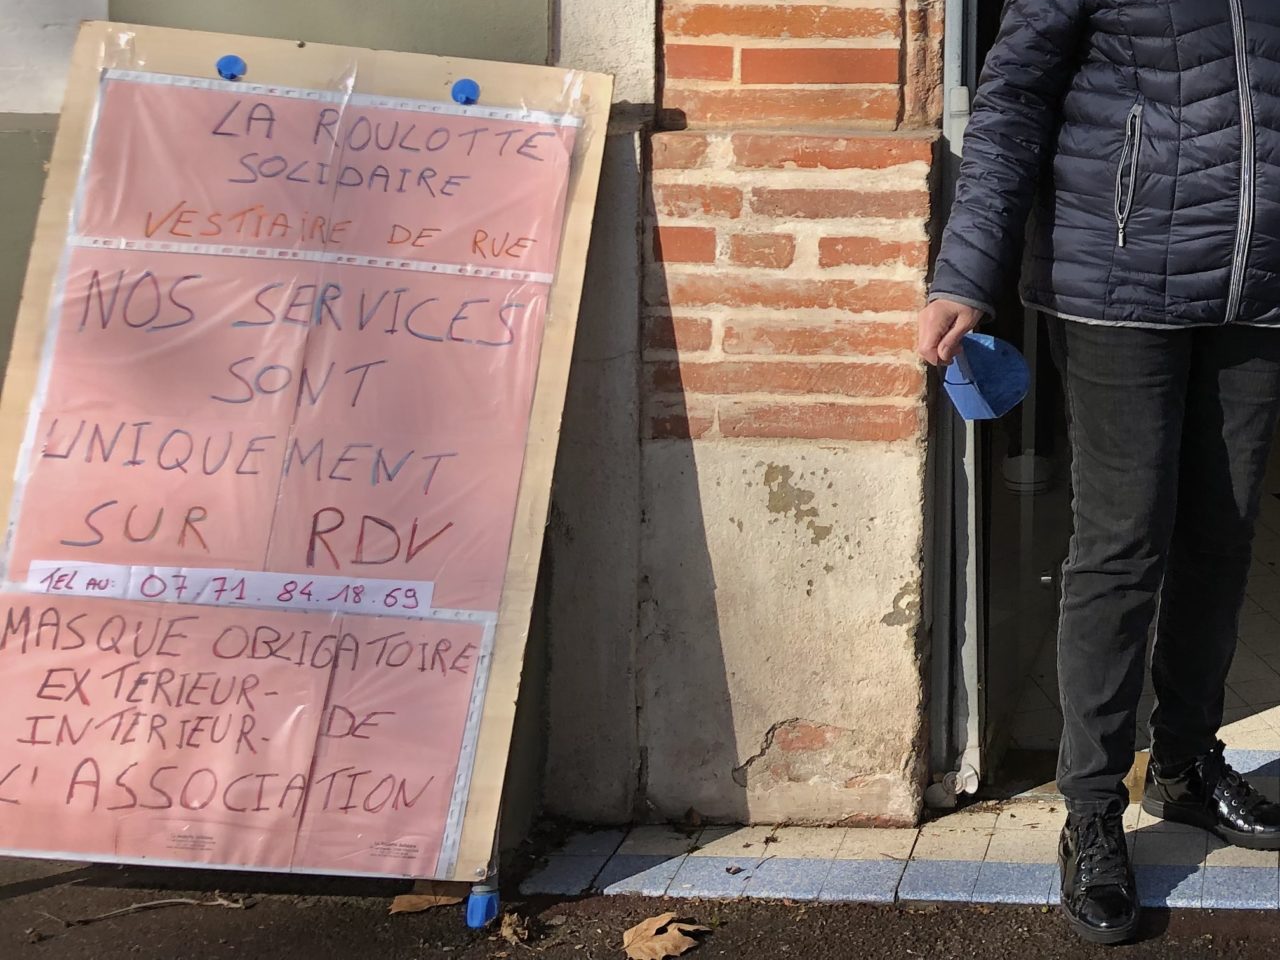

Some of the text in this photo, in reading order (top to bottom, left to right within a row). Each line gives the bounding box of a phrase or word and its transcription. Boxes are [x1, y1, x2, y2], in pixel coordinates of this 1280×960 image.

[211, 99, 556, 162] LA ROULOTTE
[227, 151, 472, 198] SOLIDAIRE
[144, 199, 539, 261] VESTIAIRE DE RUE
[77, 268, 528, 348] NOS SERVICES
[210, 355, 389, 409] SONT
[42, 417, 459, 496] UNIQUEMENT
[59, 499, 455, 571] SUR RDV
[39, 566, 76, 592] TEL
[0, 606, 480, 676] MASQUE OBLIGATOIRE
[319, 702, 398, 742] DE
